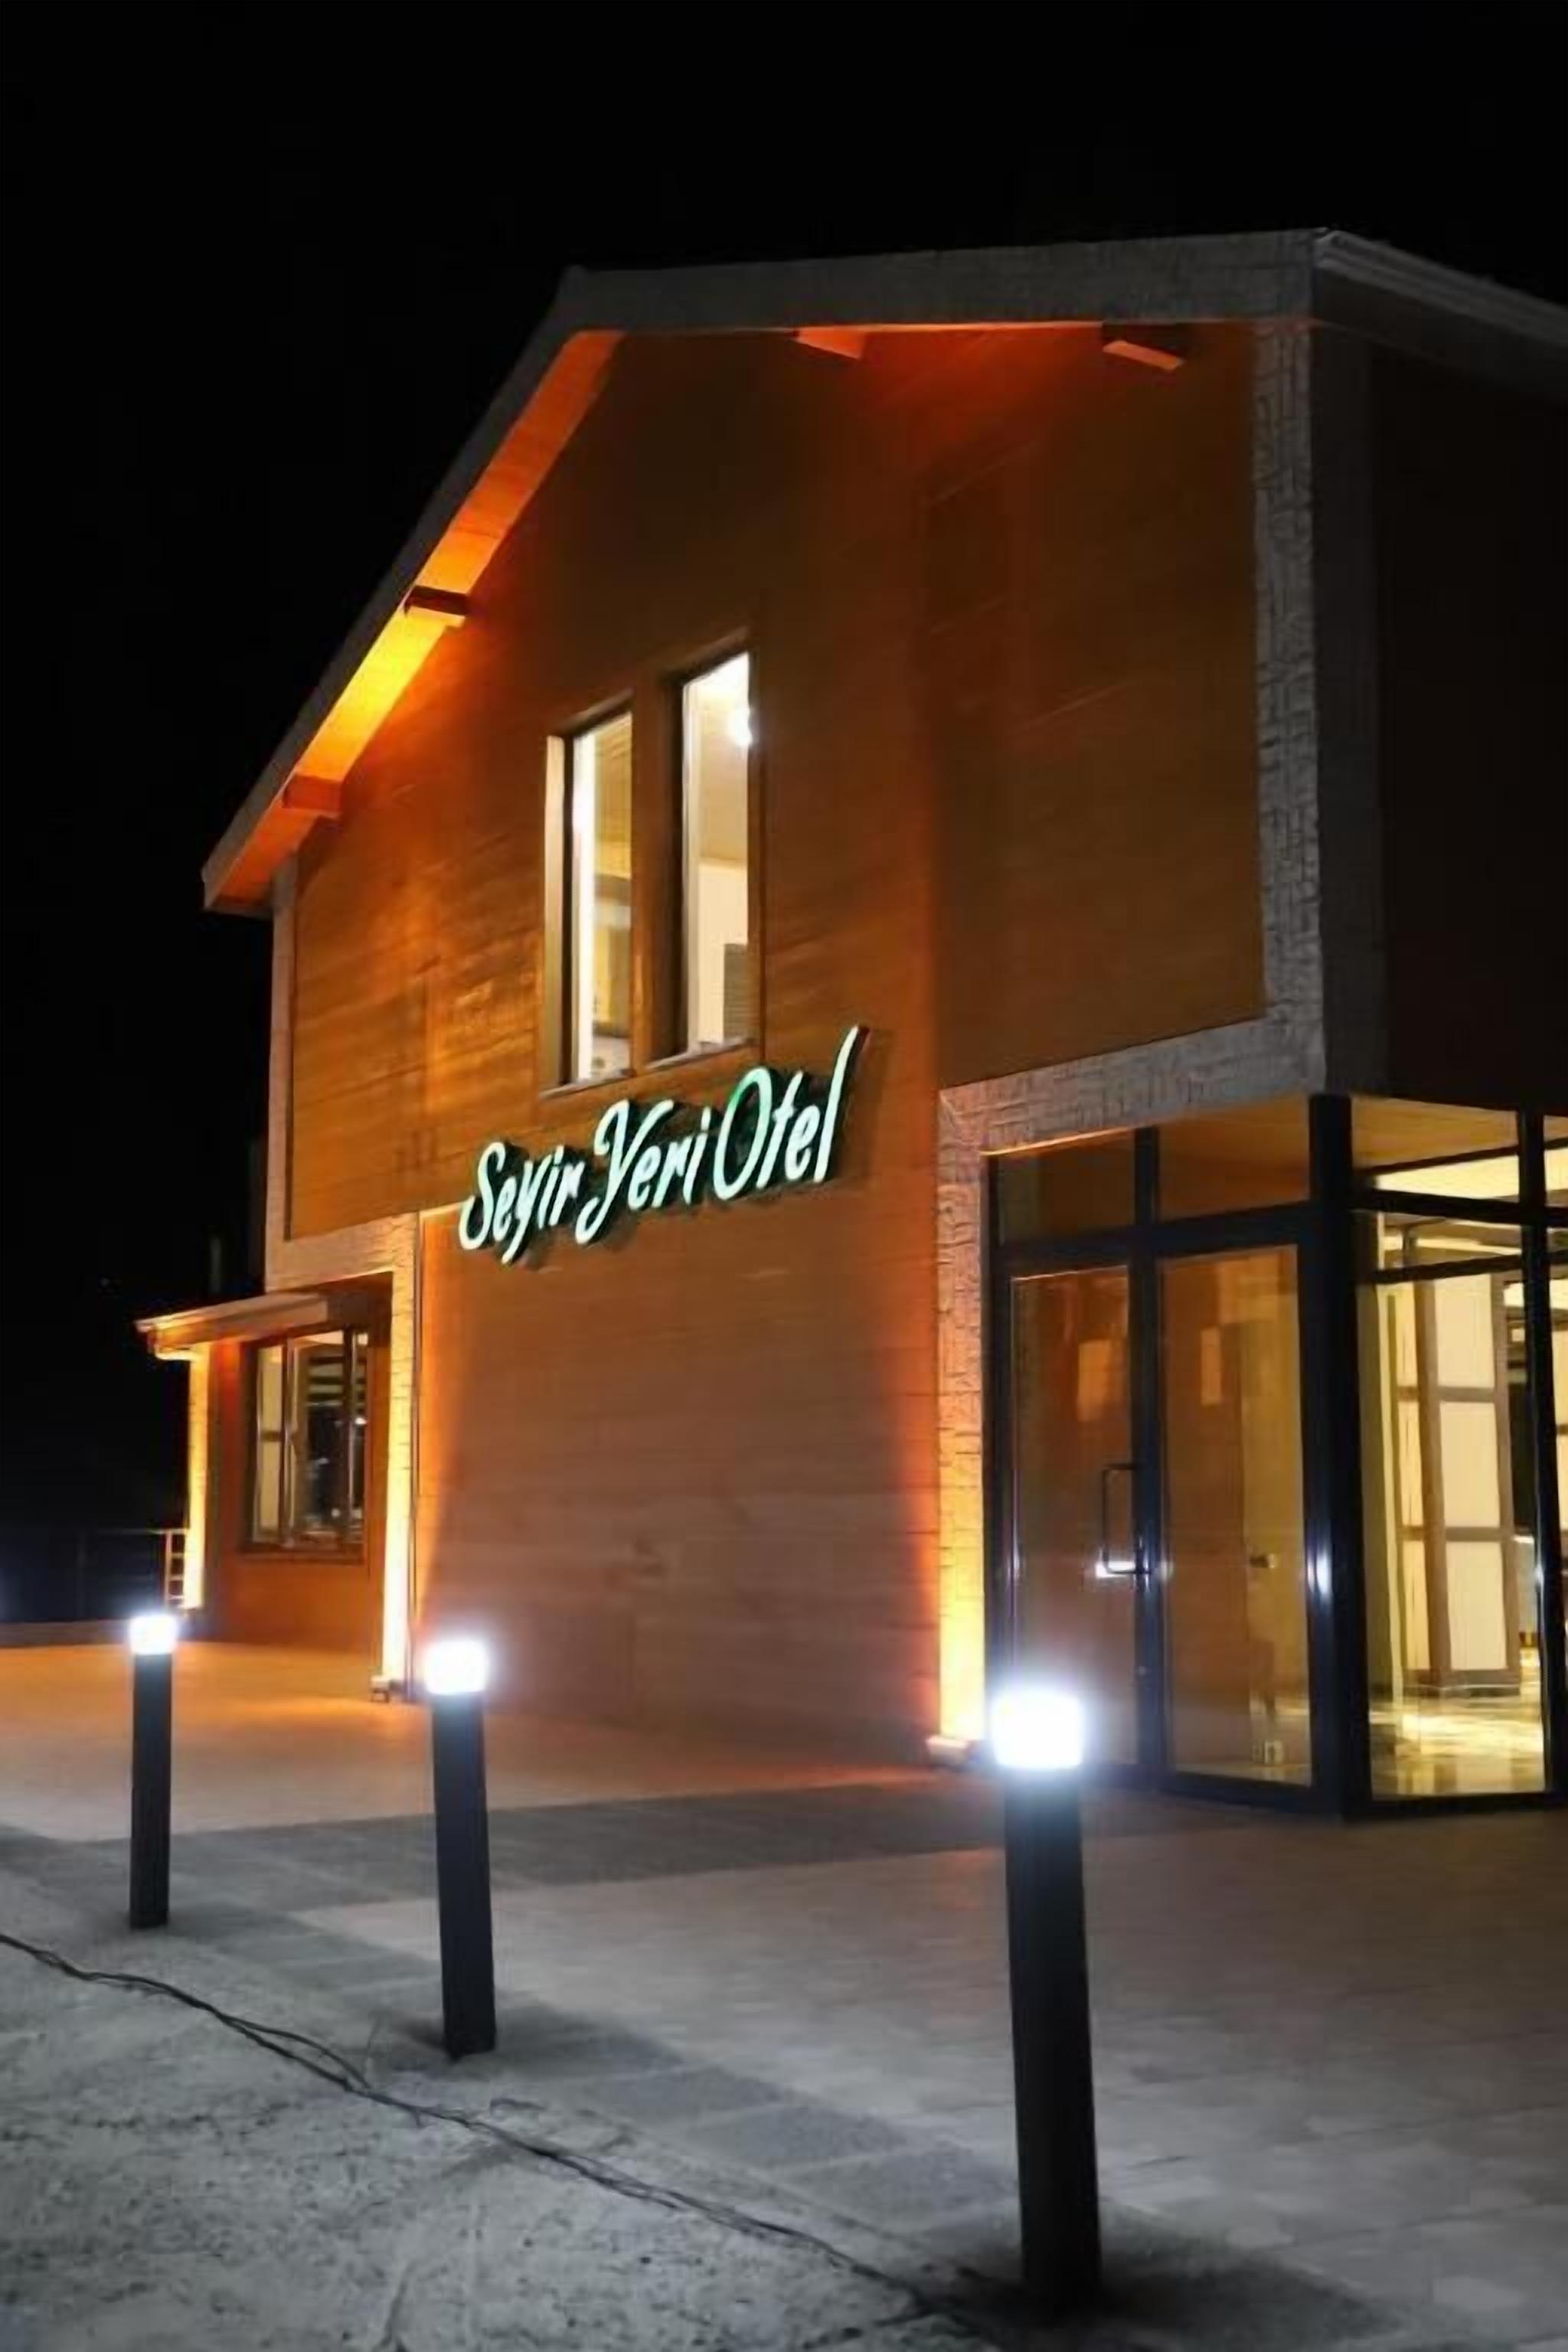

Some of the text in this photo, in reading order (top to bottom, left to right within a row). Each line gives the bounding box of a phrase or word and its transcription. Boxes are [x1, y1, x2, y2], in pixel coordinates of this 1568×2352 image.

[458, 1024, 860, 1265] Seyir Yeri Otel
